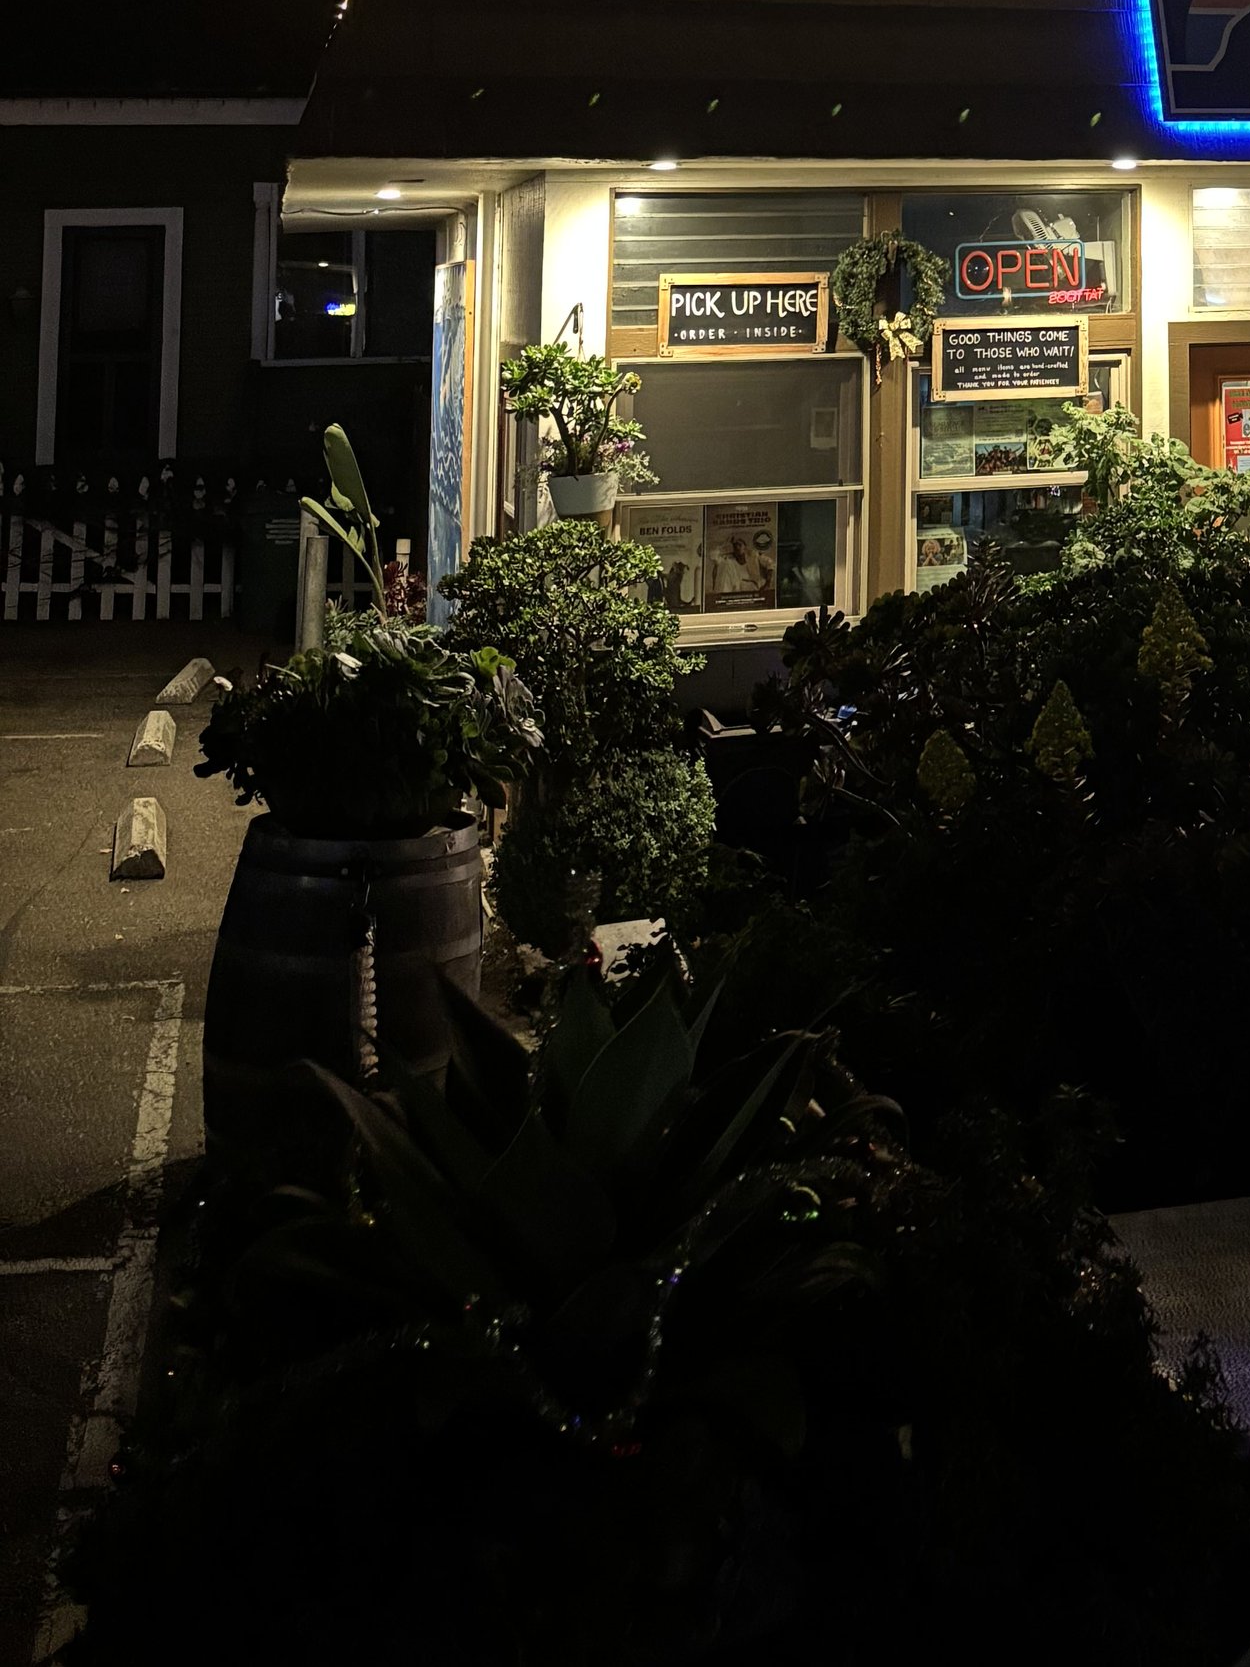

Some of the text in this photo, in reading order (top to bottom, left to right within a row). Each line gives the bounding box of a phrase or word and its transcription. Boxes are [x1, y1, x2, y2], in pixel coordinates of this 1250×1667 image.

[961, 248, 1080, 291] OPEN
[671, 289, 818, 318] PICK UP HERE
[680, 326, 797, 340] ORDER INSIDE
[948, 330, 1070, 346] GOOD THINGS COME
[946, 348, 965, 360] TO
[973, 347, 1013, 359] THOSE
[1016, 346, 1040, 358] WHO
[954, 366, 965, 374] all
[957, 381, 979, 389] THANK
[639, 525, 692, 536] BEN FOLDS
